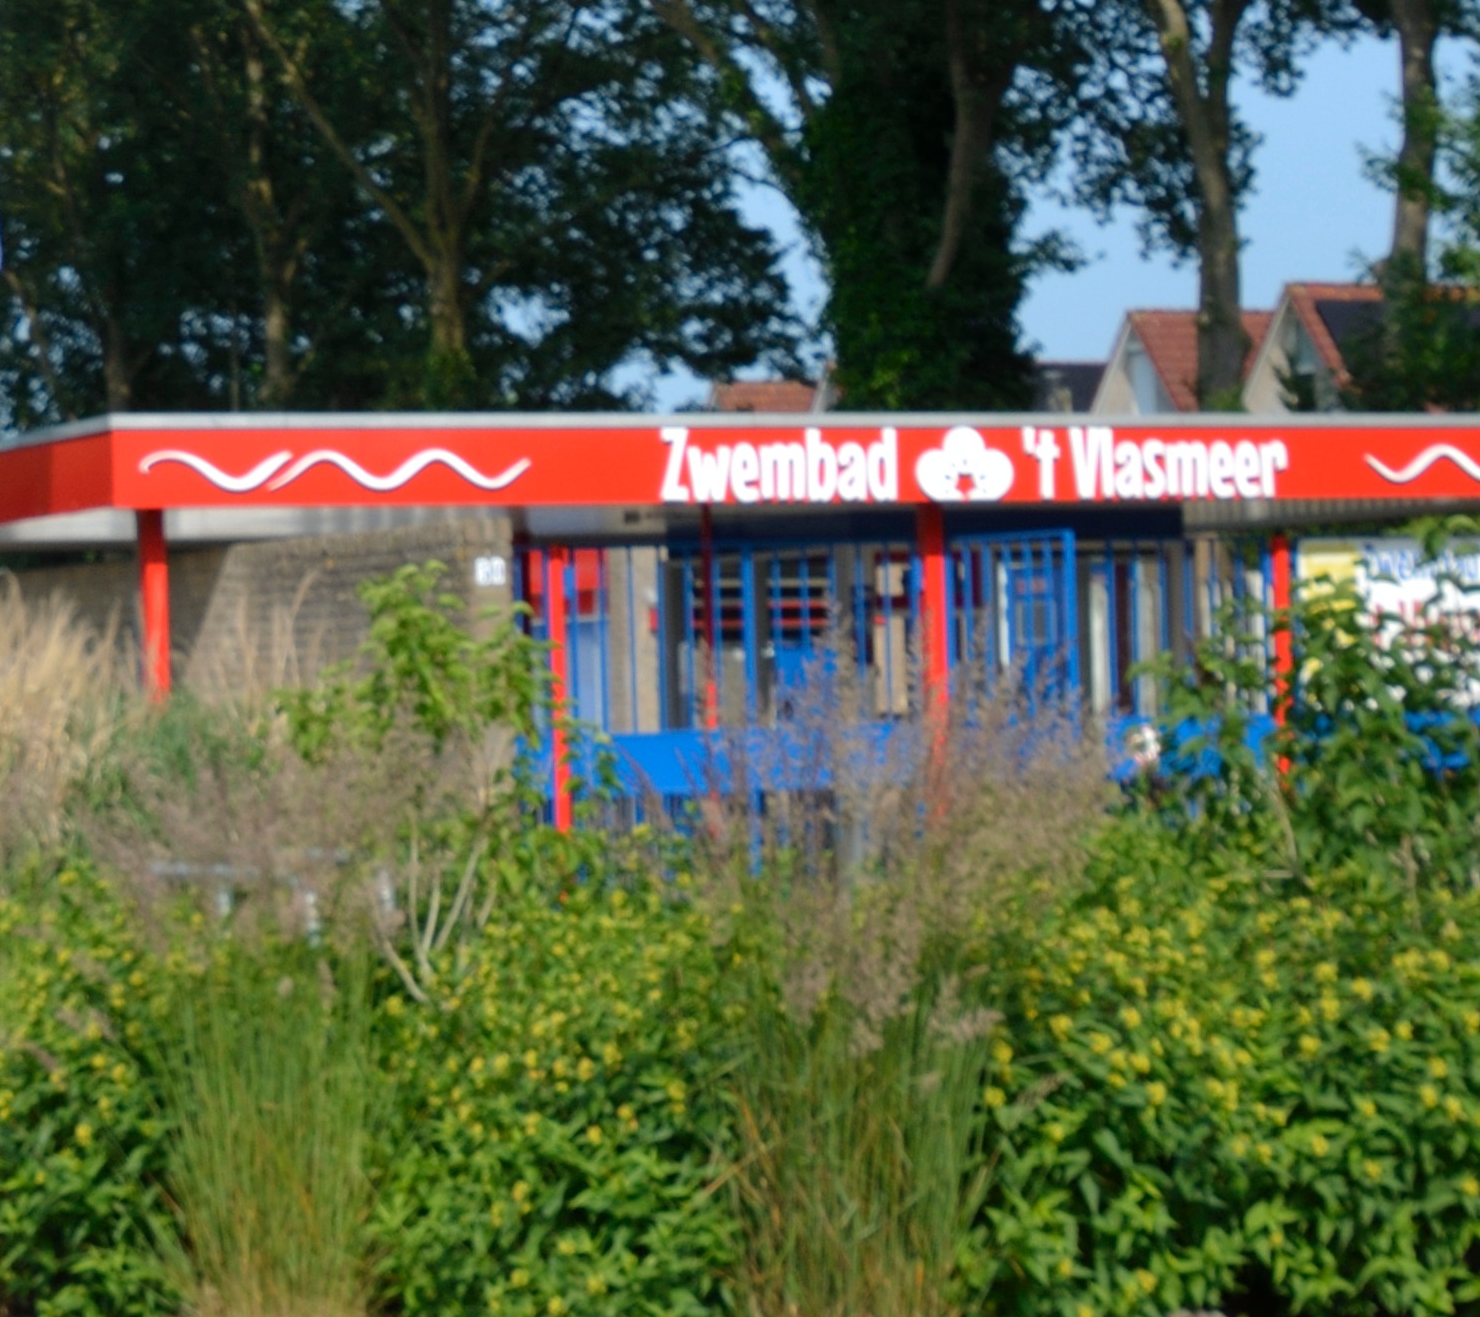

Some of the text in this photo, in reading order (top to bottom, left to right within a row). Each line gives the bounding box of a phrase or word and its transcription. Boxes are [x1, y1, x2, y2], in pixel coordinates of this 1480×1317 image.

[660, 426, 1288, 502] Zwembad 't Vlasmeer
